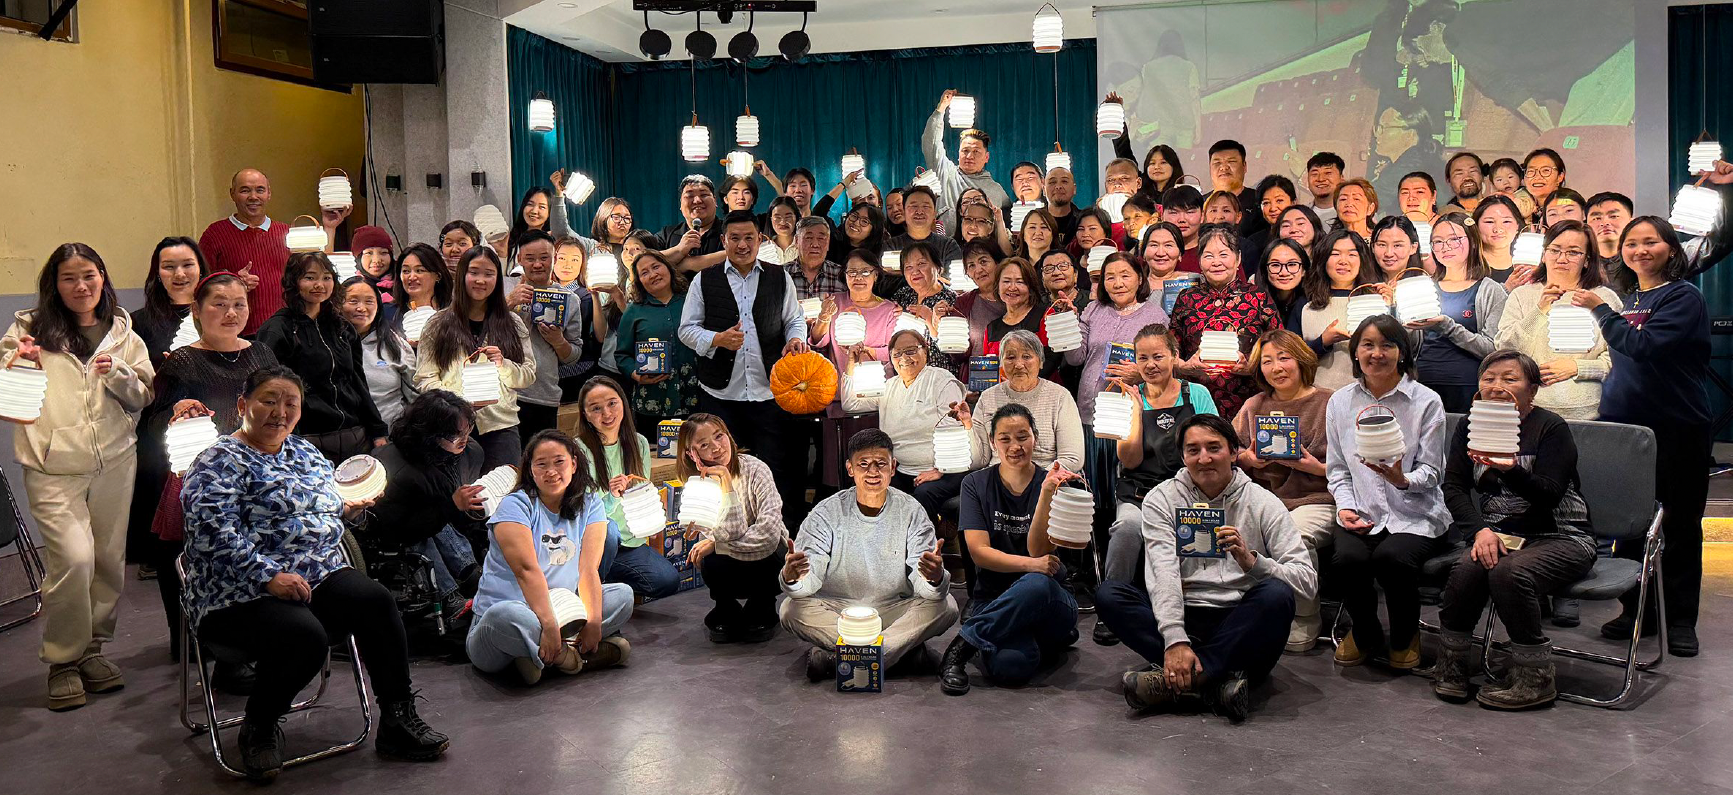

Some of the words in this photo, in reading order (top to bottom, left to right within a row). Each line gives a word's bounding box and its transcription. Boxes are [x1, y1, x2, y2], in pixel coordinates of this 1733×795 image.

[535, 292, 565, 300] HAVEN
[1112, 349, 1135, 358] HAVEN
[1179, 510, 1220, 518] HAVEN
[1180, 516, 1202, 525] 10000
